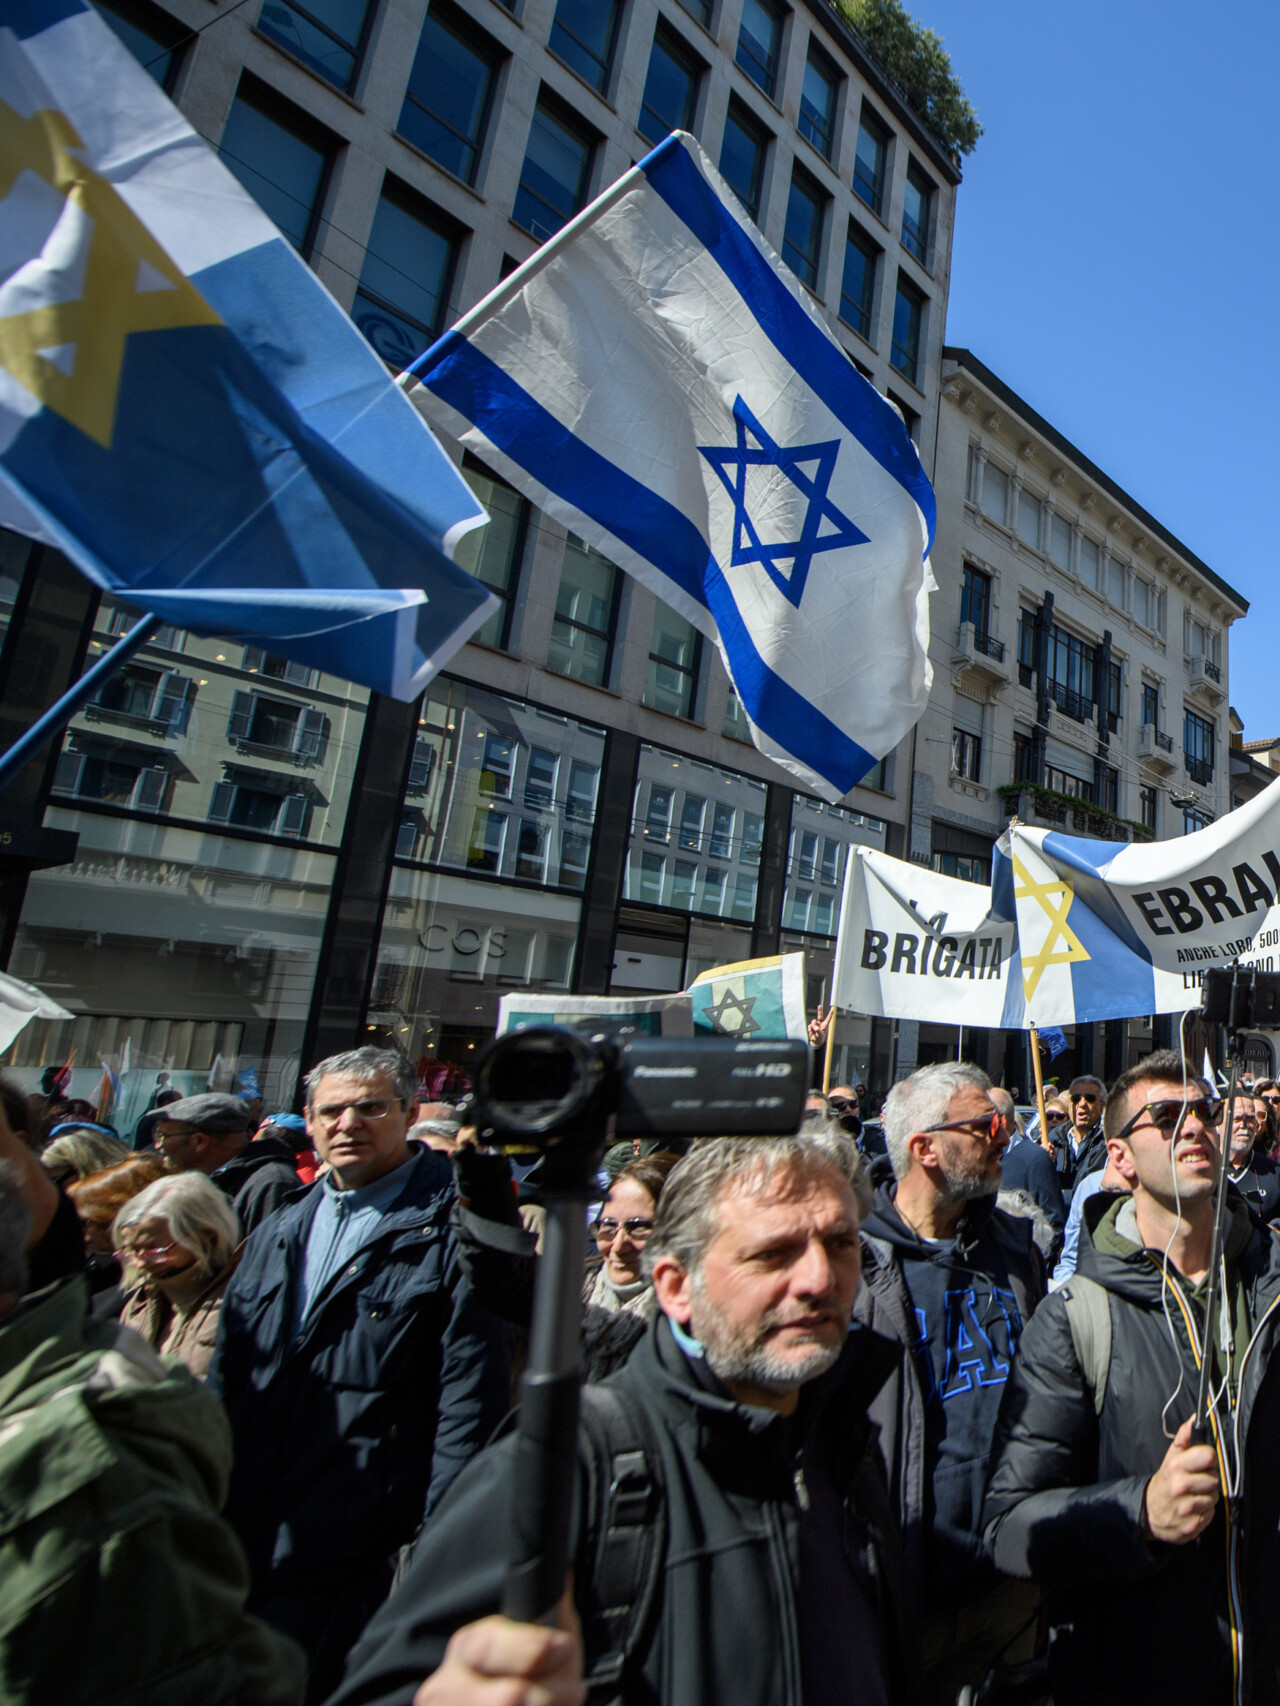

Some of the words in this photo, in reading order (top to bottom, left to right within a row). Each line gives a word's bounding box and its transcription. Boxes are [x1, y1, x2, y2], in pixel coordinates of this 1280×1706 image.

[418, 924, 508, 958] COS
[861, 929, 1002, 978] BRIGATA
[1177, 946, 1219, 963] ANCHE
